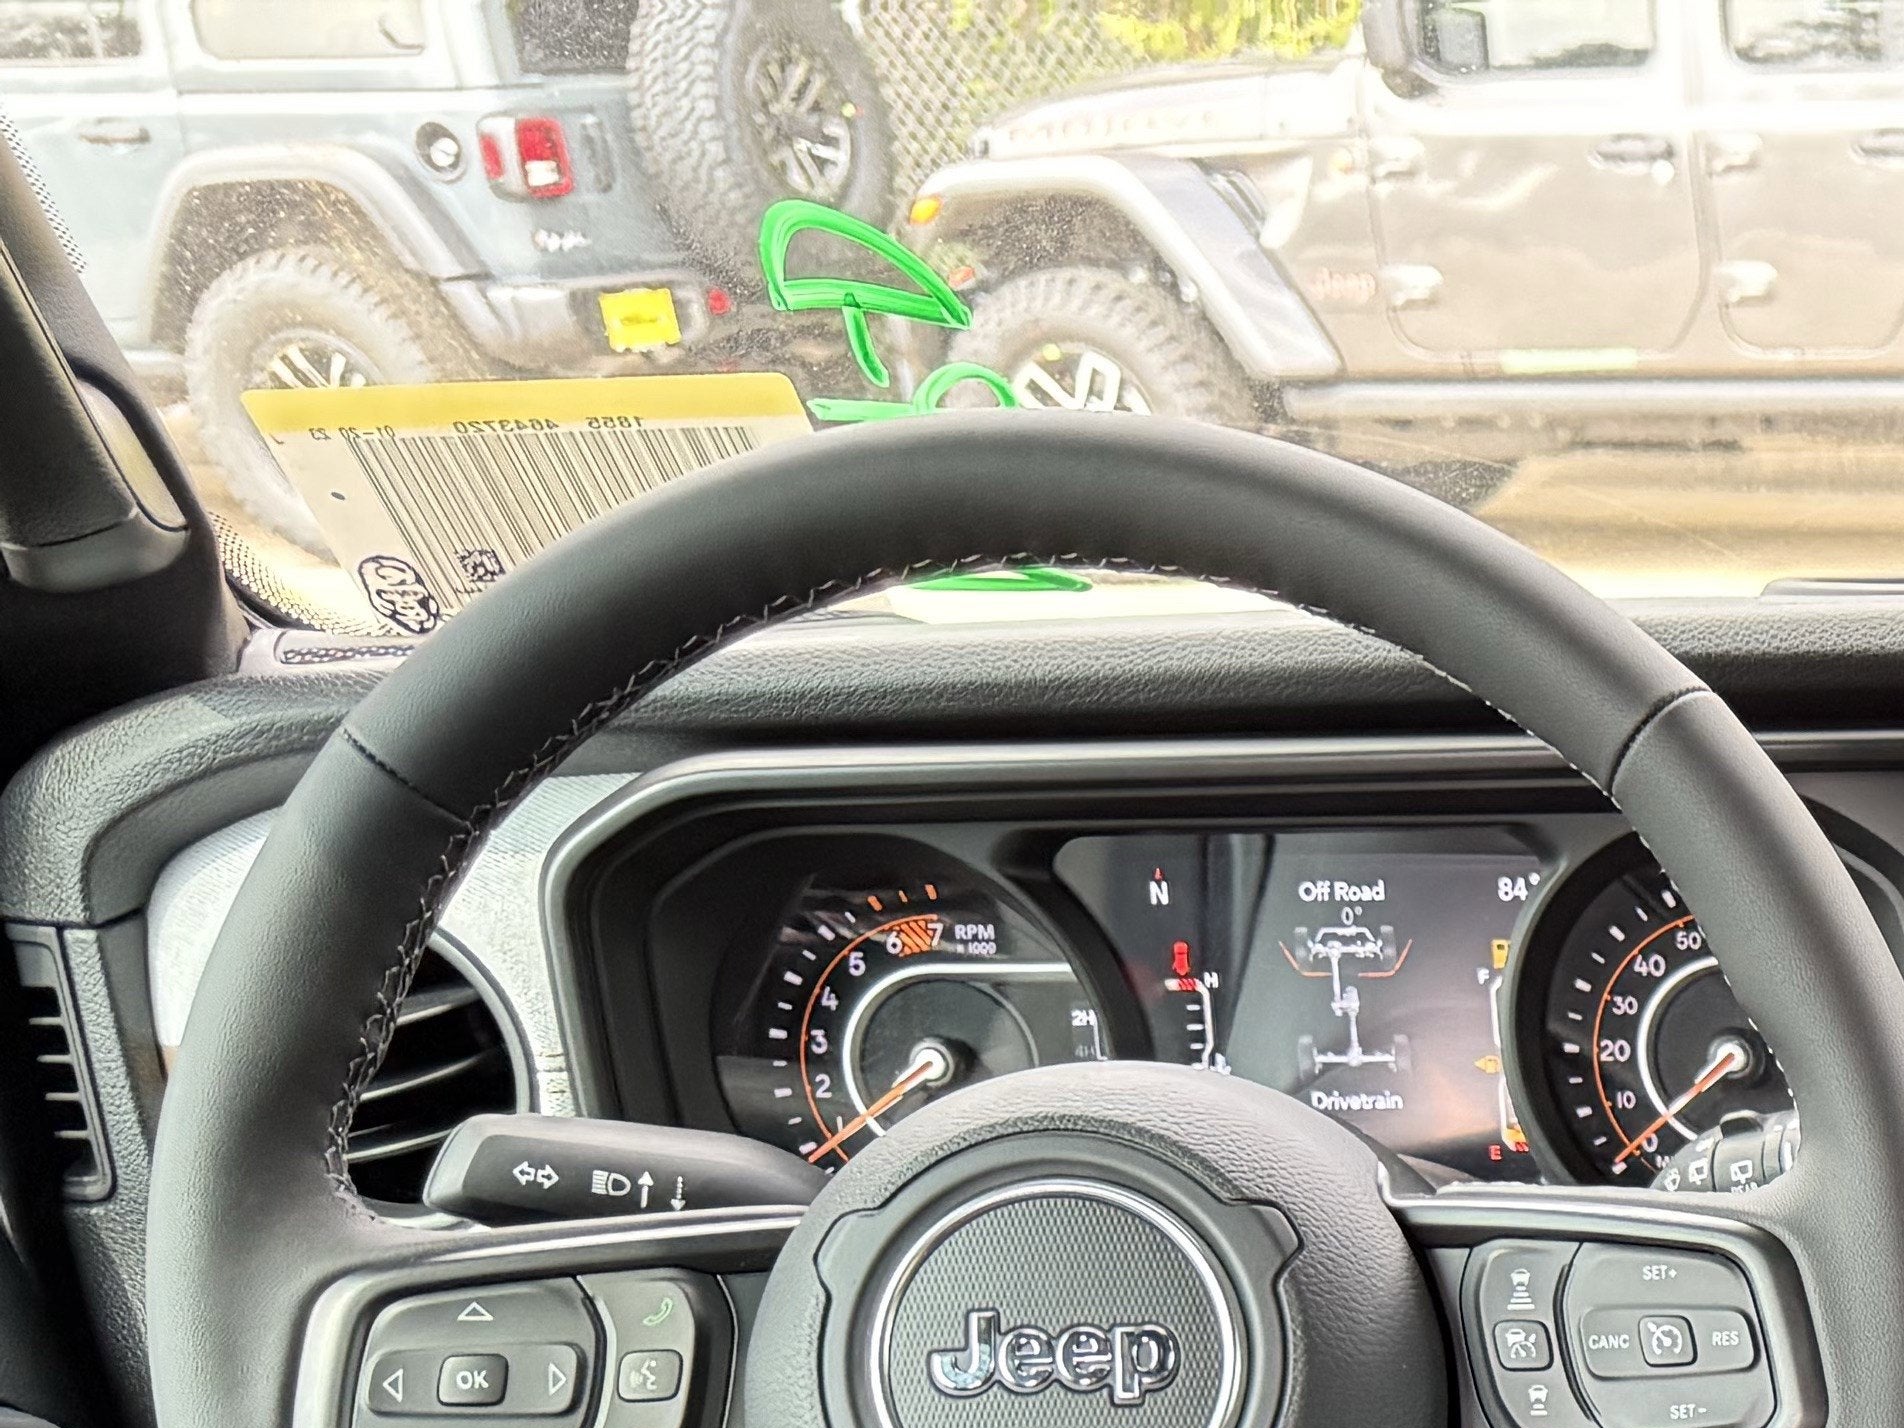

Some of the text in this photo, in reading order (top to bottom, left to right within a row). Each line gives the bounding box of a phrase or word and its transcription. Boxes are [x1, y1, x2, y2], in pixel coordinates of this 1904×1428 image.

[1149, 880, 1169, 906] N
[1298, 878, 1386, 902] Off Road
[886, 931, 903, 955] 6
[954, 923, 996, 941] RPM
[1674, 931, 1701, 951] 50
[848, 951, 866, 977] 5
[1633, 953, 1667, 978] 40
[820, 985, 840, 1011] 4
[1611, 995, 1639, 1016] 30
[810, 1028, 829, 1055] 3
[1599, 1039, 1632, 1063] 20
[815, 1073, 833, 1099] 2
[1311, 1090, 1404, 1111] Drivetrain
[1615, 1090, 1637, 1110] 10
[1588, 1333, 1630, 1350] CANC
[1711, 1330, 1740, 1347] RES
[927, 1307, 1181, 1408] Jeep
[456, 1371, 491, 1391] OK
